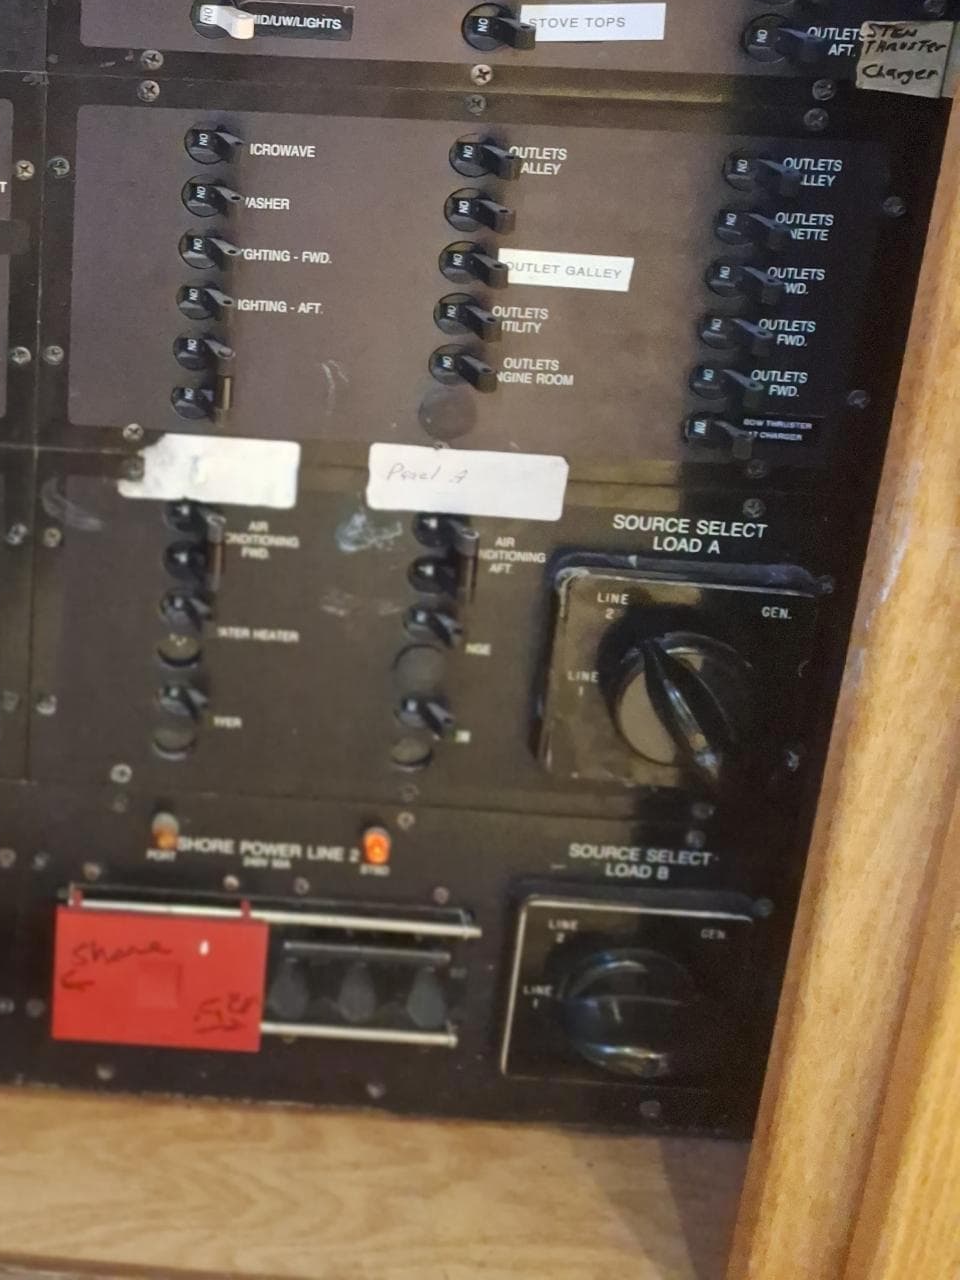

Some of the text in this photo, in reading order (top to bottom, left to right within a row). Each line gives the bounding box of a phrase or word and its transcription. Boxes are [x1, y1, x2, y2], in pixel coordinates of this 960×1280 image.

[529, 17, 626, 29] STOVE TOPS
[828, 44, 855, 56] AFT.
[250, 143, 316, 157] ICROWAVE
[509, 146, 567, 161] OUTLETS
[521, 163, 561, 176] ALLEY
[783, 157, 842, 171] OUTLETS
[775, 212, 834, 226] OUTLETS
[302, 252, 332, 264] FWD.
[506, 262, 622, 279] OUTLET GALLEY
[767, 266, 825, 280] OUTLETS
[298, 303, 323, 314] AFT.
[492, 306, 549, 319] OUTLETS
[759, 319, 816, 332] OUTLETS
[776, 335, 807, 347] FWD.
[503, 357, 560, 371] OUTLETS
[536, 372, 574, 386] ROOM
[751, 369, 808, 383] OUTLETS
[768, 385, 799, 397] FWD.
[613, 514, 768, 538] SOURCE SELECT
[495, 537, 515, 548] AIR
[653, 537, 720, 554] LOAD A
[597, 592, 629, 605] LINE
[605, 608, 614, 619] 2
[762, 607, 791, 619] GEN.
[253, 629, 298, 642] HEATER
[568, 671, 598, 683] LINE
[177, 836, 359, 862] SHORE POWER LINE 2
[569, 844, 712, 865] SOURCE SELECT
[606, 863, 668, 879] LOAD B
[549, 920, 577, 930] LINE
[524, 986, 553, 995] LINE
